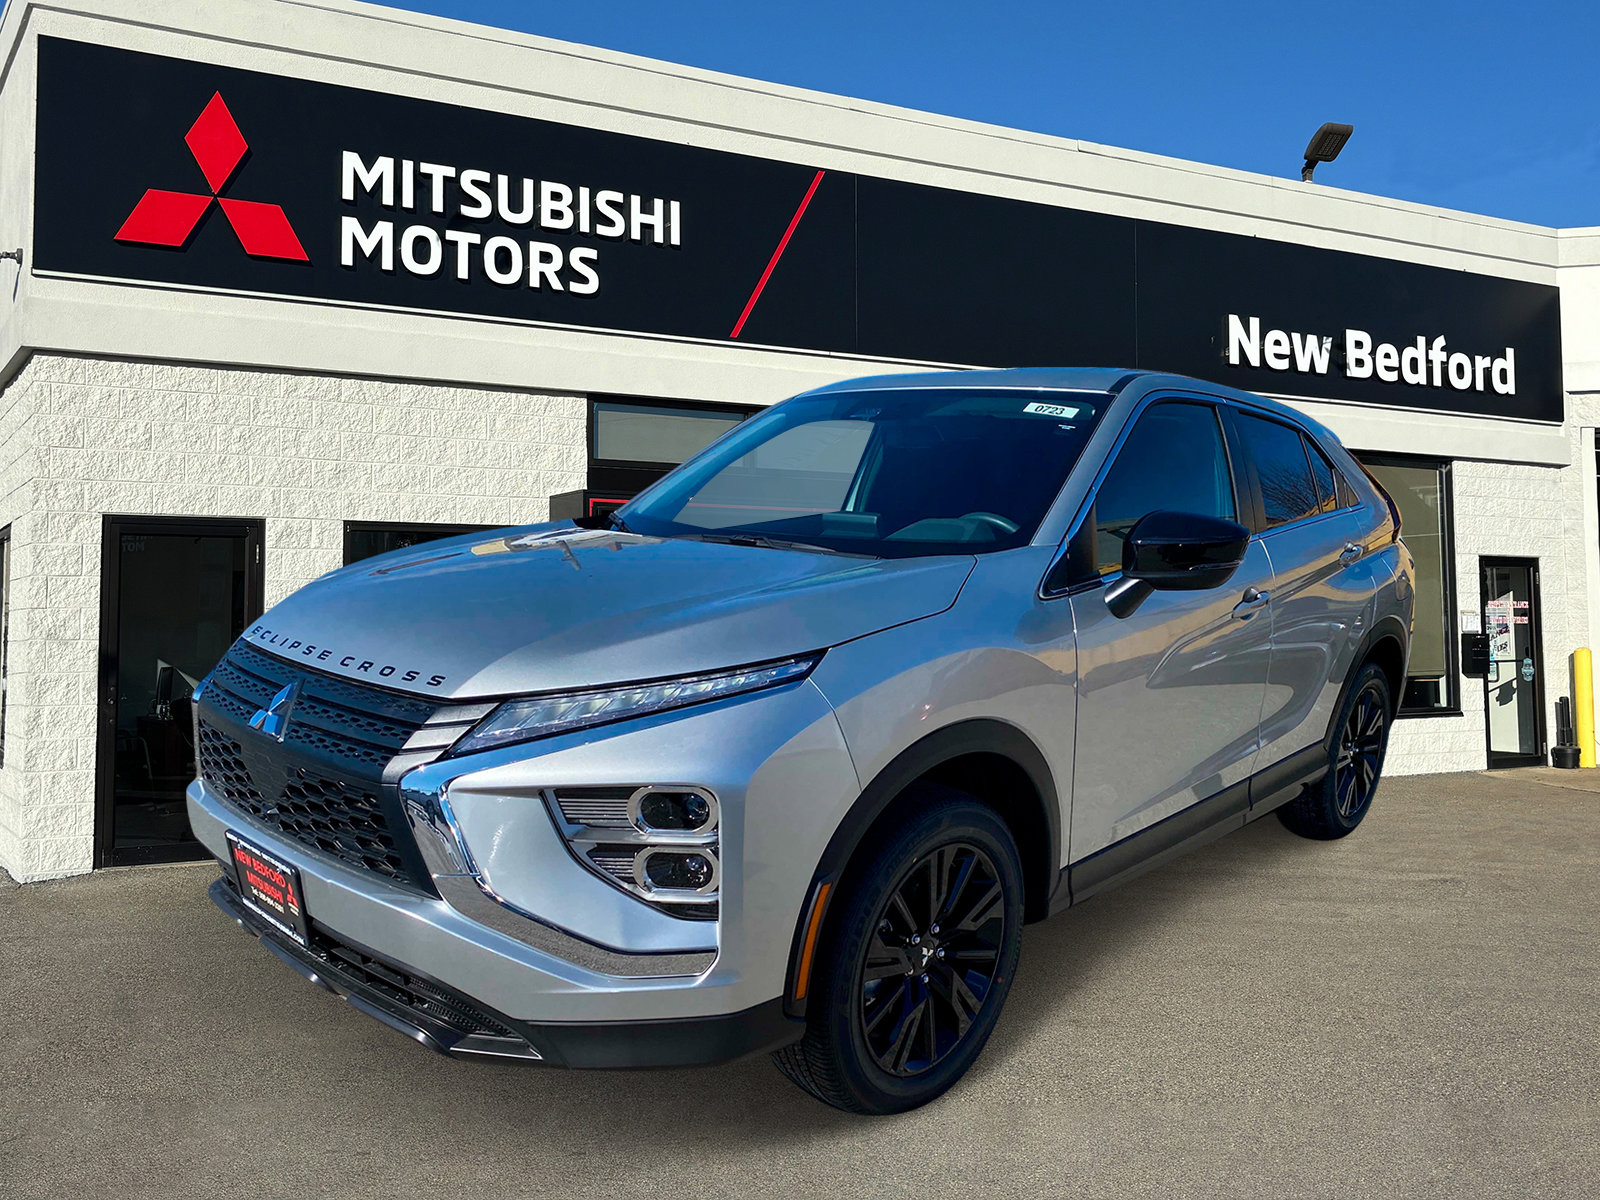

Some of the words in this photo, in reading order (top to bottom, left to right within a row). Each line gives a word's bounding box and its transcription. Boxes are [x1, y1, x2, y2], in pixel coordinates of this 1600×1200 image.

[341, 150, 681, 246] MITSUBISHI
[340, 215, 600, 295] MOTORS
[1228, 313, 1333, 375] New
[1345, 328, 1516, 395] Bedford
[1034, 405, 1066, 416] 0723
[251, 625, 333, 661] ECLIPSE
[339, 656, 447, 687] CROSS
[234, 848, 252, 867] NEW
[252, 858, 286, 888] BEDFORD
